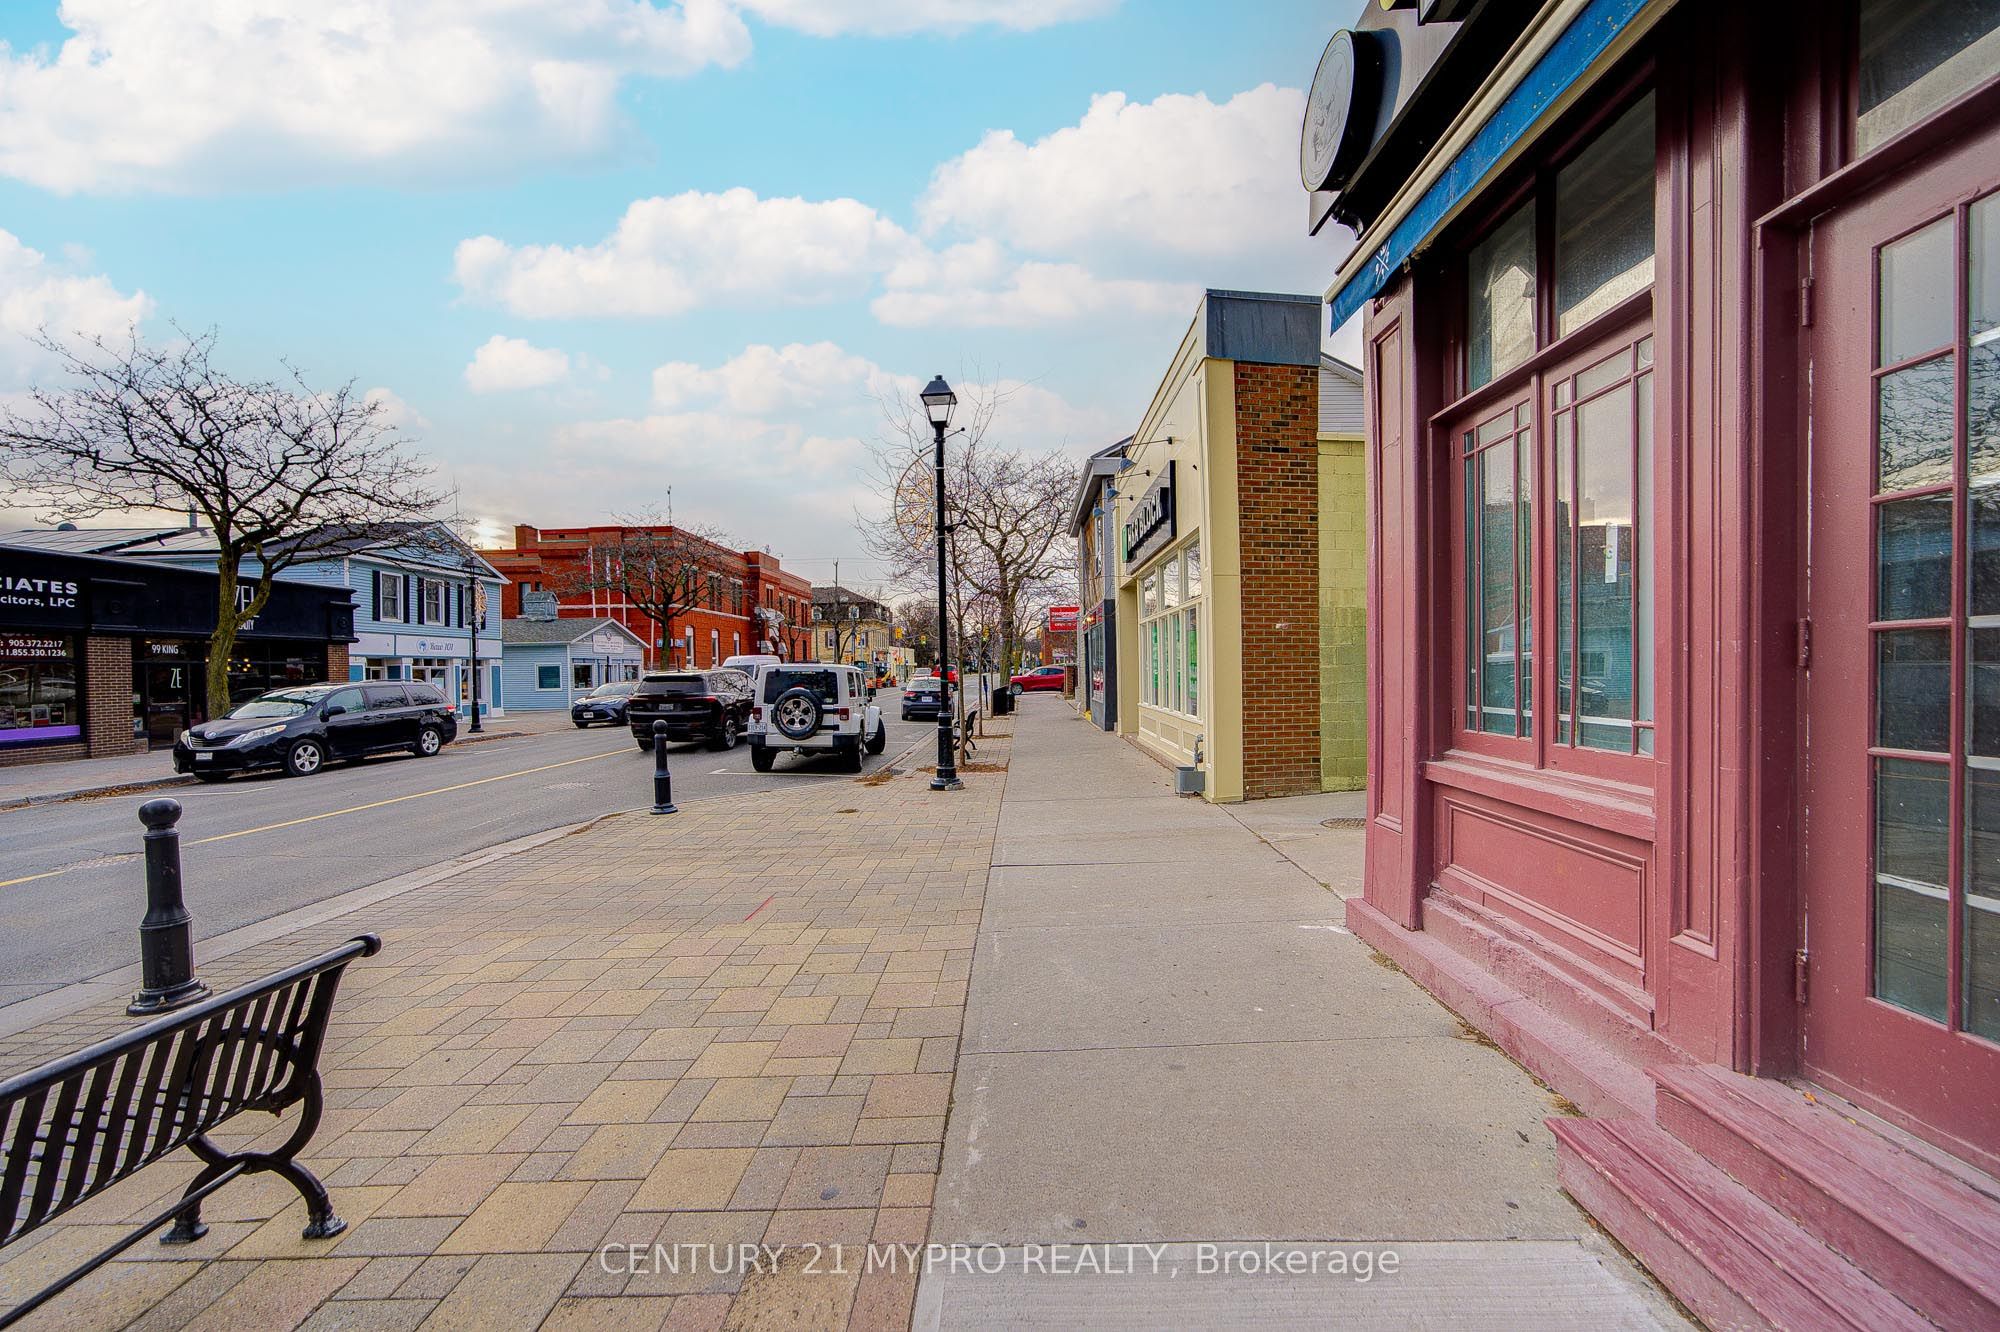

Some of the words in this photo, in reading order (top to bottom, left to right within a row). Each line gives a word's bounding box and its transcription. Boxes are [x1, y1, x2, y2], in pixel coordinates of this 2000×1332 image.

[0, 576, 78, 595] IATES
[49, 597, 76, 608] LPC
[8, 639, 63, 648] 905.372.2217
[151, 644, 161, 655] 99
[161, 644, 179, 655] KING
